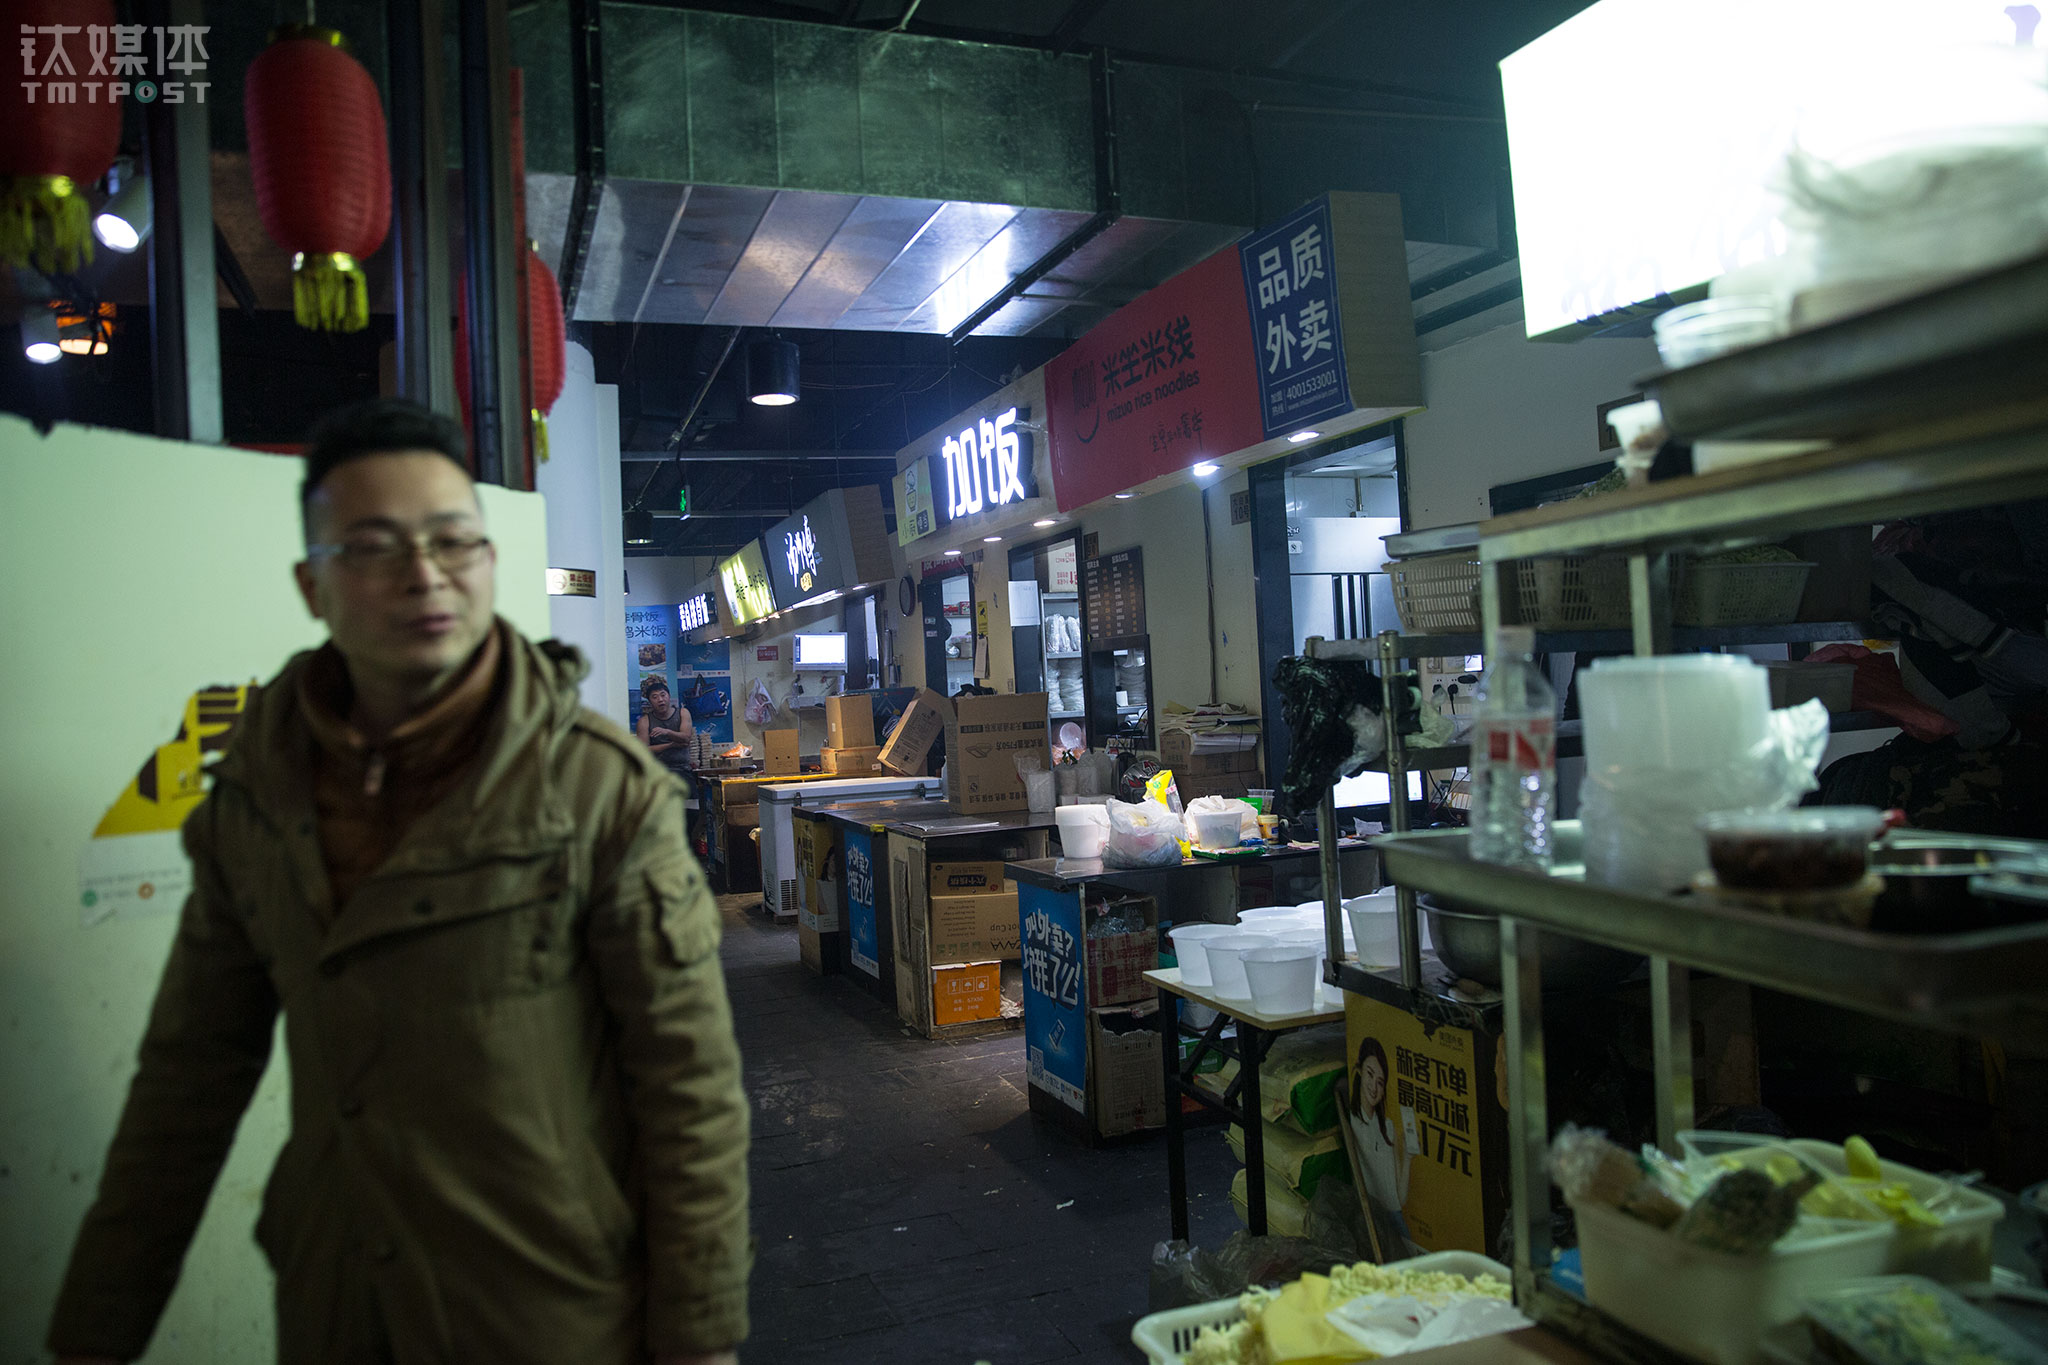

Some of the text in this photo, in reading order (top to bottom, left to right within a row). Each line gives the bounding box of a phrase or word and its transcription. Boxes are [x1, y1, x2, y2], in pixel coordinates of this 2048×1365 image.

[1258, 224, 1325, 310] 品质
[1265, 299, 1332, 375] 外卖
[1107, 369, 1200, 423] mizuo rice noodles
[1286, 369, 1338, 400] 4001533001
[942, 407, 1025, 520] 加饭
[989, 923, 1006, 933] Cup
[1025, 907, 1074, 959] 叫外卖?
[1395, 1045, 1468, 1096] 新客下单
[1397, 1077, 1470, 1134] 最高立减
[1419, 1119, 1473, 1178] 17元
